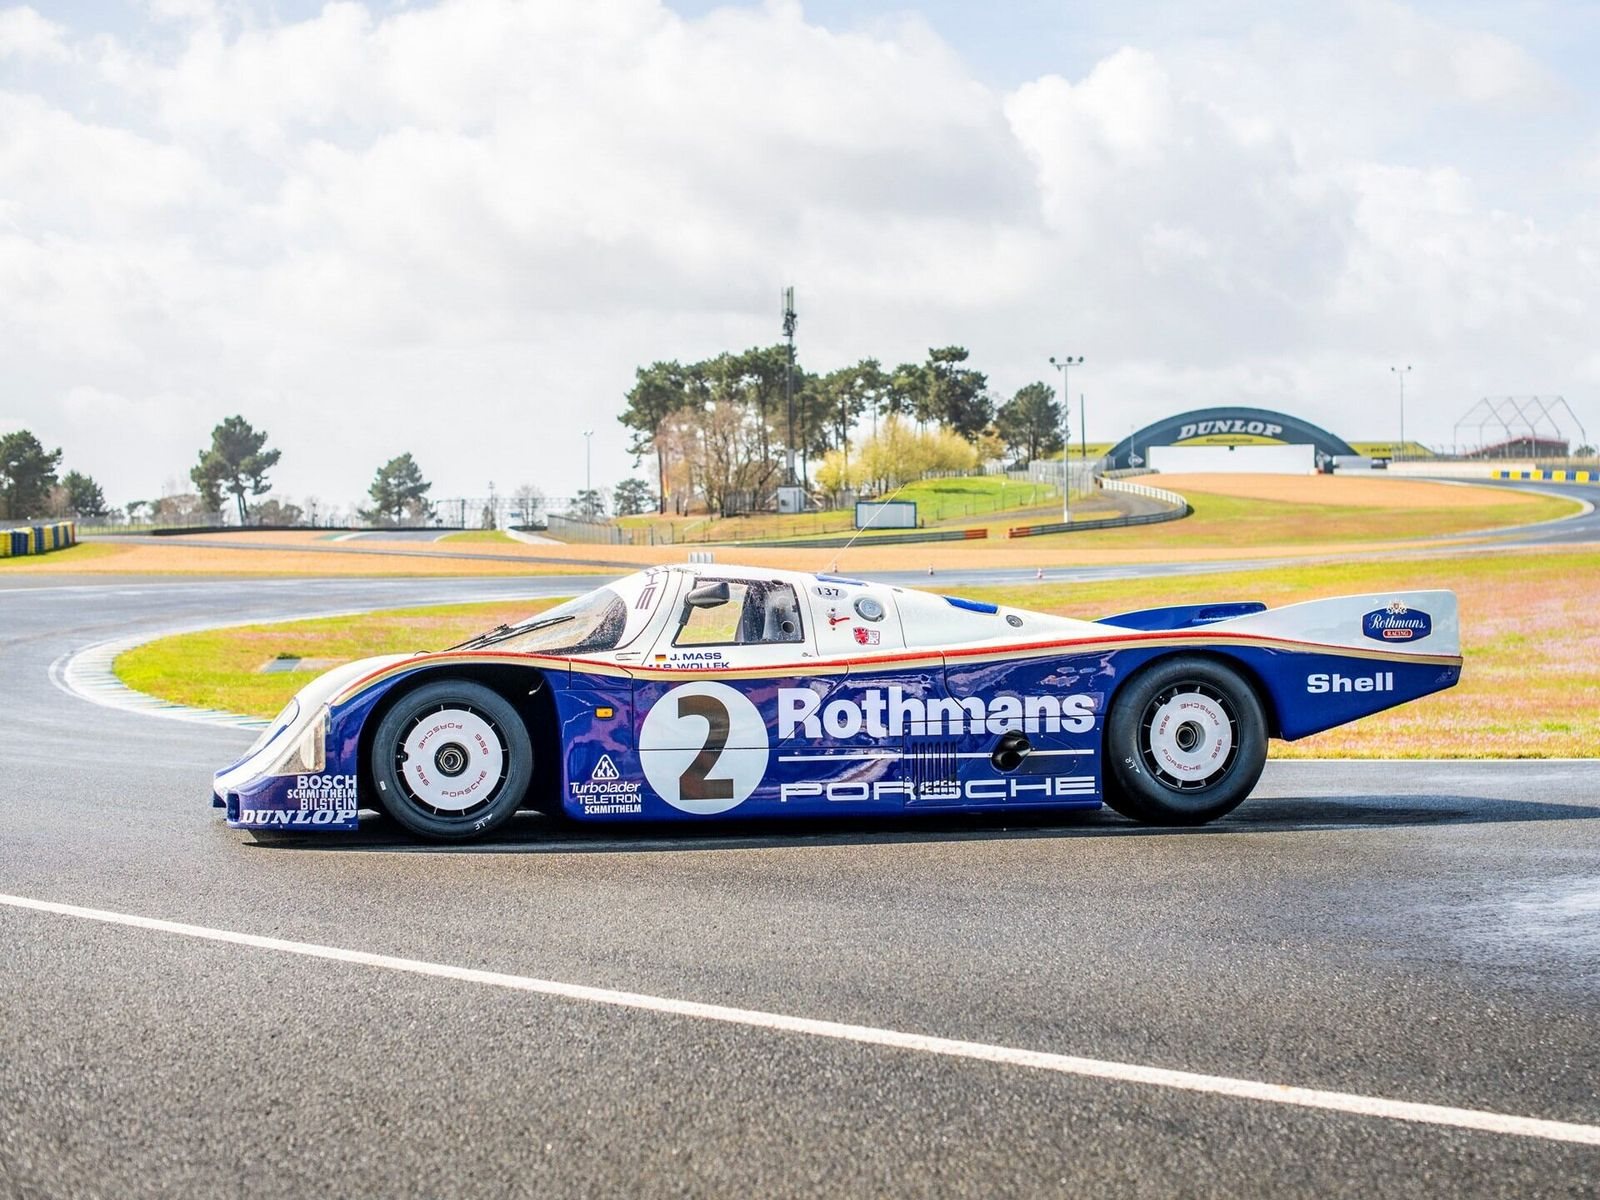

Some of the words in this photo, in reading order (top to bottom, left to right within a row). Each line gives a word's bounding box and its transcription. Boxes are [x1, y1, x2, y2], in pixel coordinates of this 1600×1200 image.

[1177, 420, 1282, 440] DUNLOP
[817, 587, 839, 596] 137
[683, 652, 722, 660] MASS
[1307, 672, 1393, 693] Shell
[778, 686, 1096, 739] Rothmans
[1180, 702, 1220, 726] PORSCHE
[1160, 715, 1170, 735] 956
[418, 723, 463, 749] PORSCHE
[475, 733, 489, 755] 956
[677, 695, 734, 800] 2
[1211, 739, 1222, 759] 956
[1162, 749, 1202, 771] PORSCHE
[297, 774, 357, 789] BOSCH
[416, 765, 430, 786] 956
[442, 771, 487, 797] PORSCHE
[287, 788, 357, 799] SCHMITTHELM
[570, 781, 641, 794] Turbolader
[780, 776, 1096, 801] PORSCHE
[300, 798, 357, 811] BILSTEIN
[577, 794, 641, 804] TELETRON
[584, 804, 642, 814] SCHMITTHELM
[240, 810, 357, 824] DUNLOP
